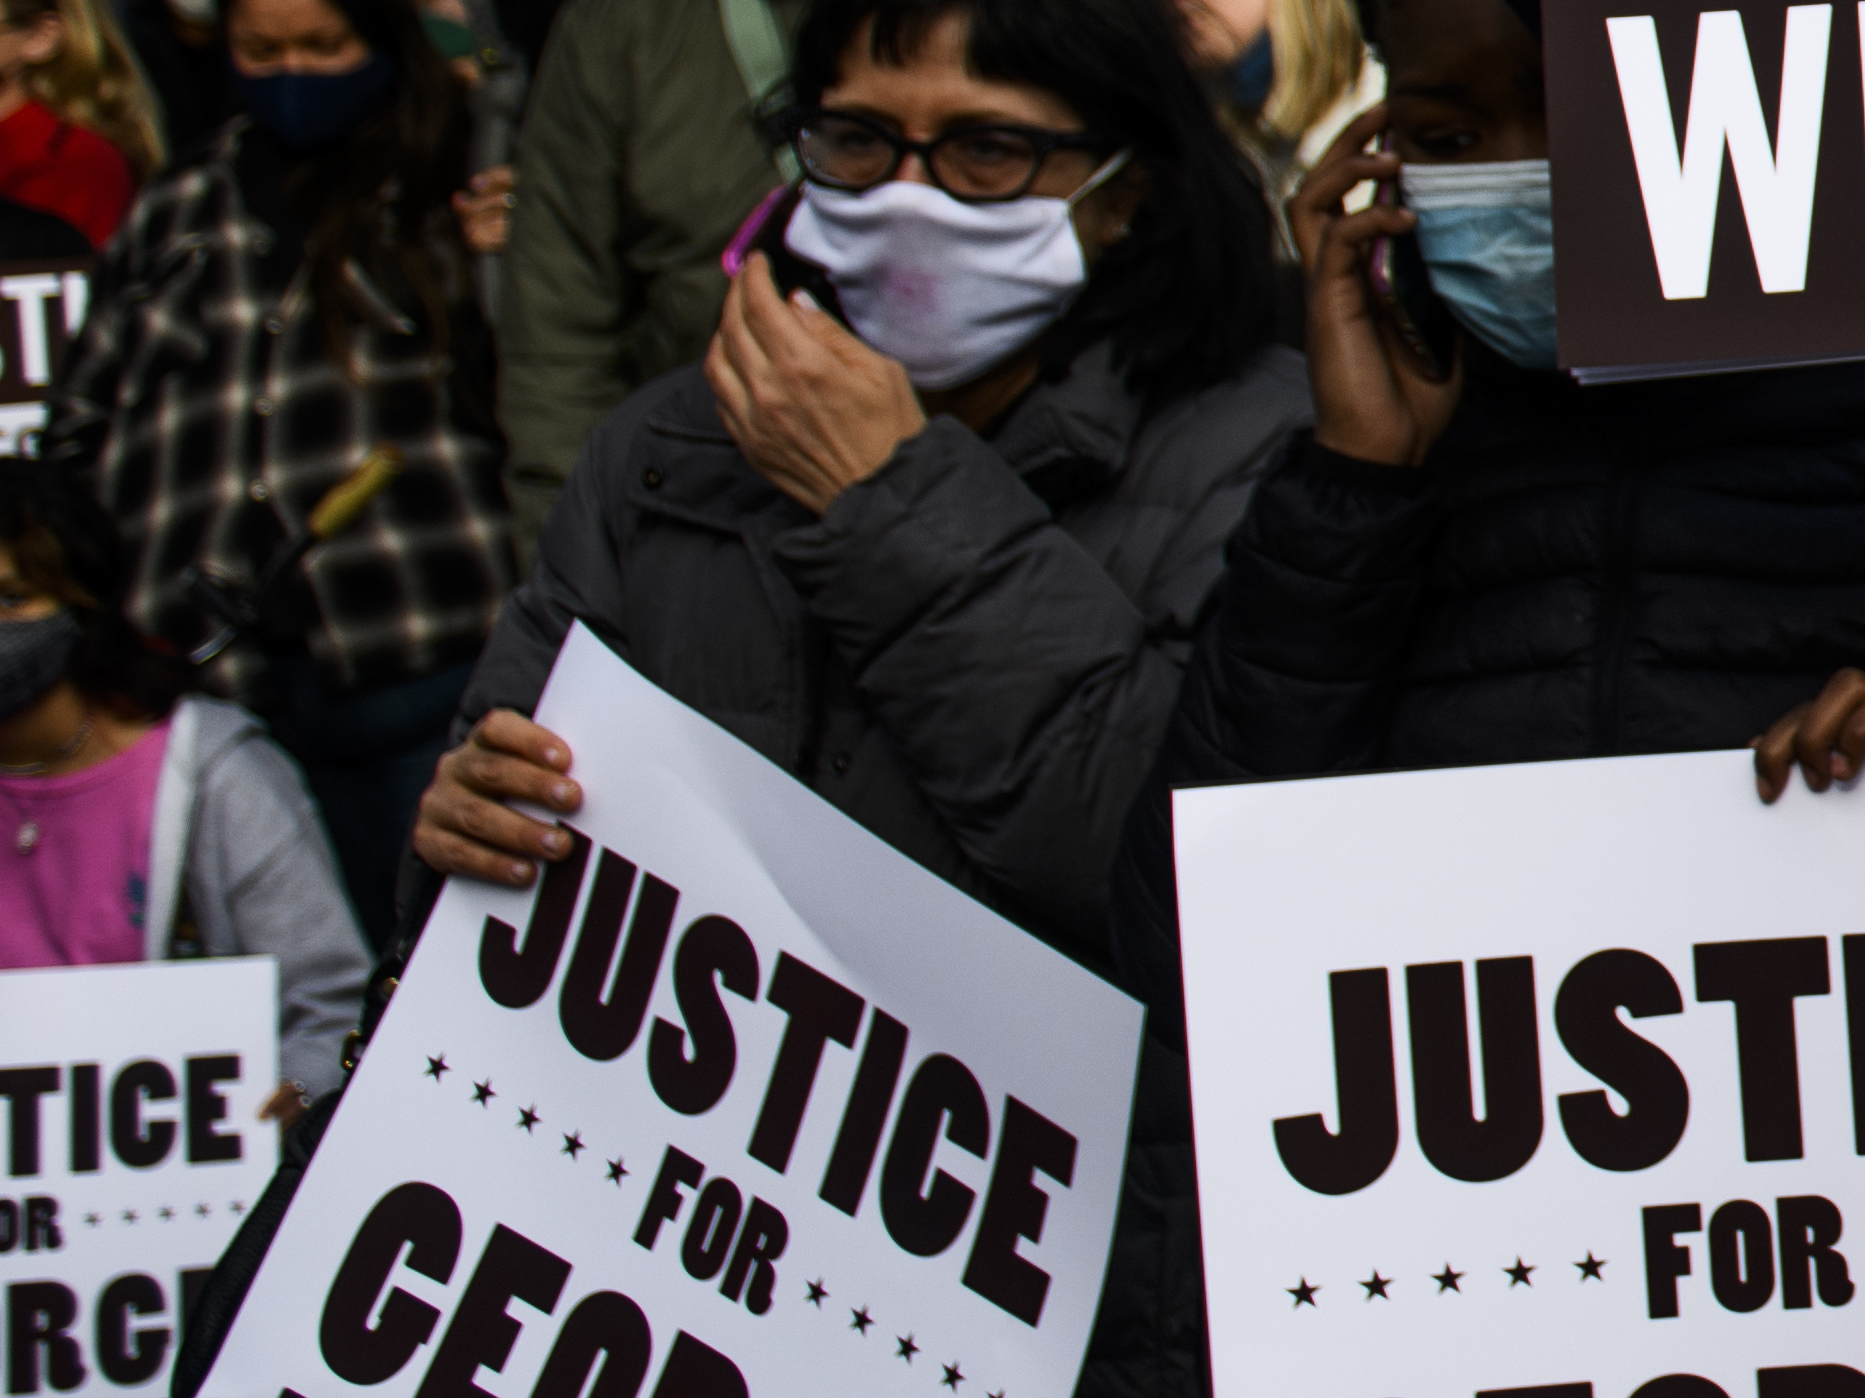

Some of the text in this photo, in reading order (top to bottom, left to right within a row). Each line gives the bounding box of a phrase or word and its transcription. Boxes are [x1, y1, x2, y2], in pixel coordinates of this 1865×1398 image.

[477, 818, 1079, 1328] JUSTICE
[633, 1144, 789, 1316] FOR
[1642, 1195, 1855, 1319] FOR
